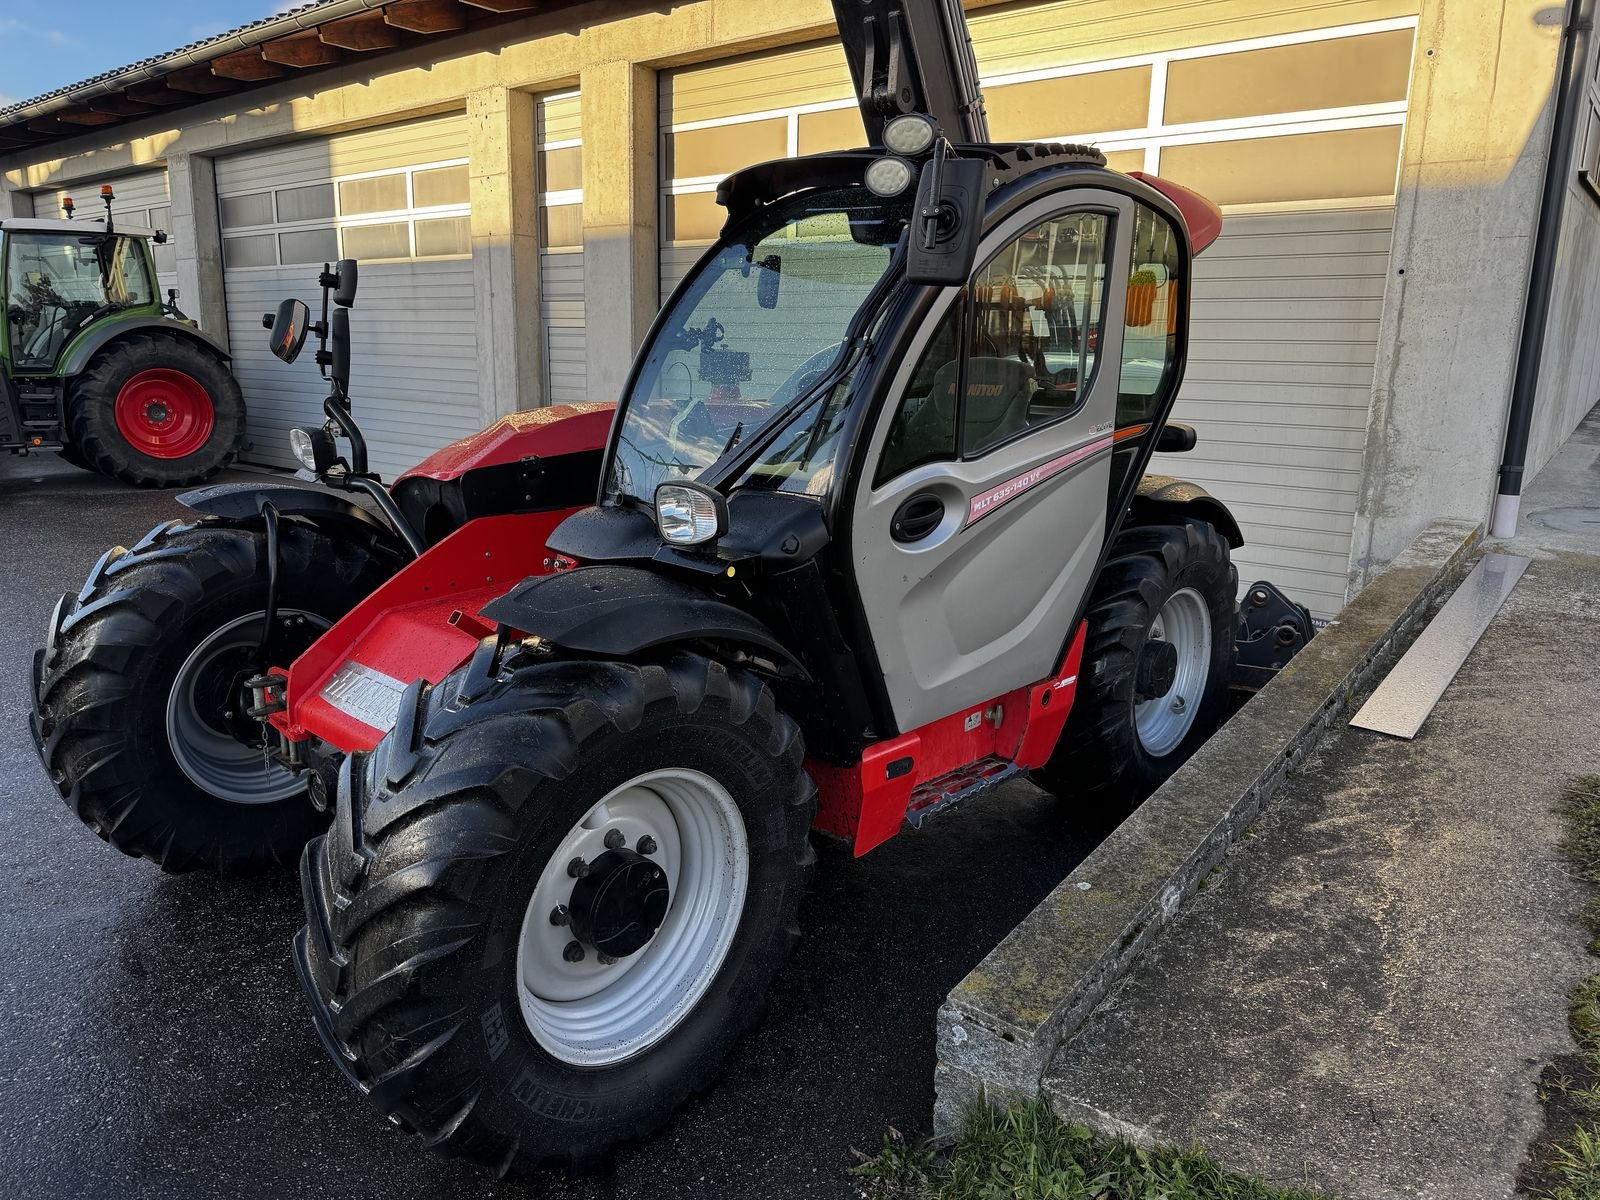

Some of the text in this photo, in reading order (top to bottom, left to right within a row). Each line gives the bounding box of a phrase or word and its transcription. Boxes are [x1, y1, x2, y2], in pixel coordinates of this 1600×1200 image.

[947, 383, 1004, 396] MNITOU
[973, 496, 993, 512] MLT
[993, 477, 1029, 502] 635-140
